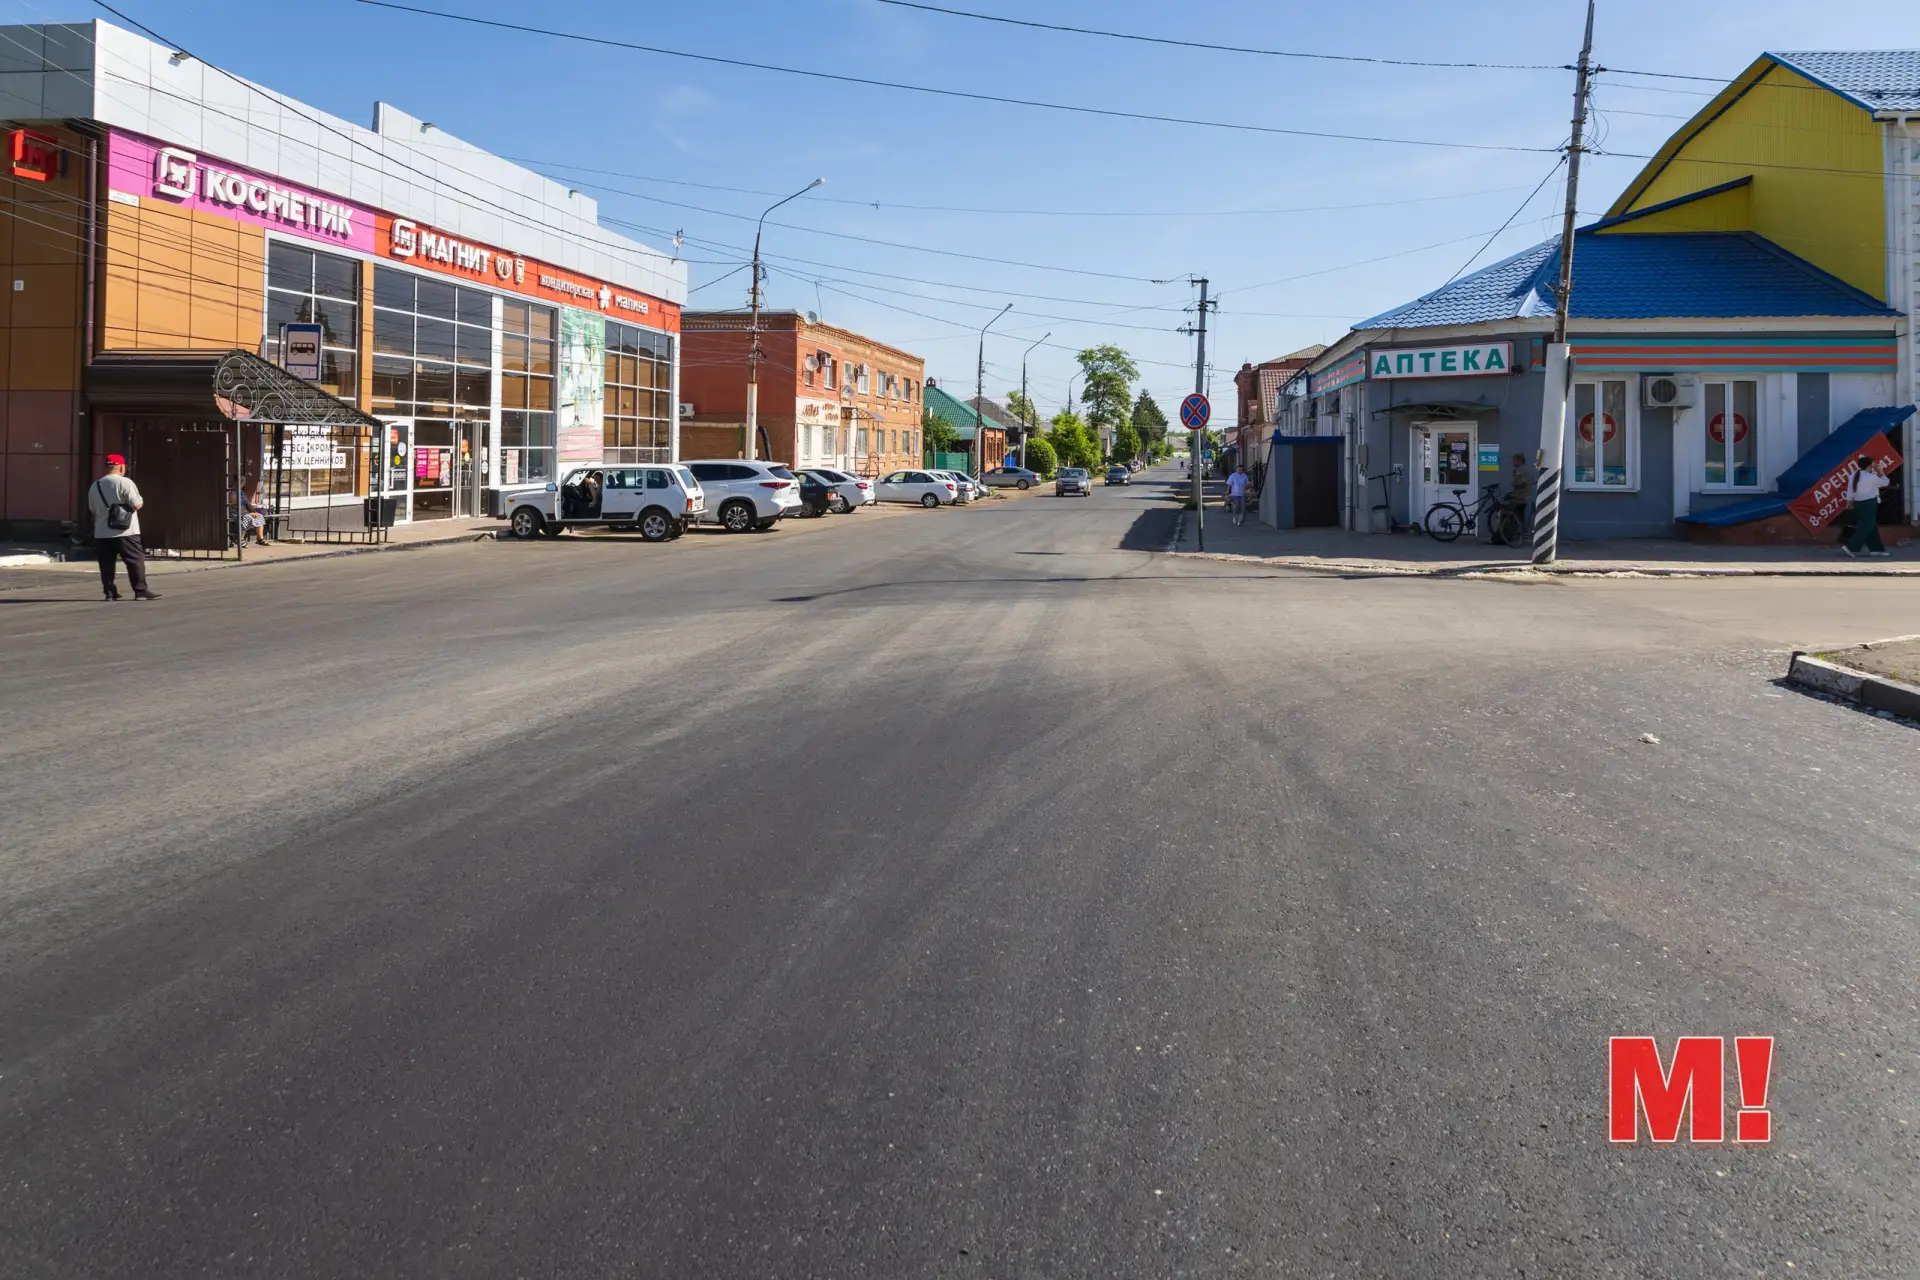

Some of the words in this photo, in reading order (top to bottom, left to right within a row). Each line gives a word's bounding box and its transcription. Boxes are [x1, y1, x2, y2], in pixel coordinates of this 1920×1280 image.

[205, 167, 353, 236] КОСМЕТИК
[420, 231, 491, 273] МАГНИТ
[615, 294, 648, 314] малина
[1374, 348, 1505, 375] АПТЕКА
[1813, 454, 1865, 503] АРЕНД
